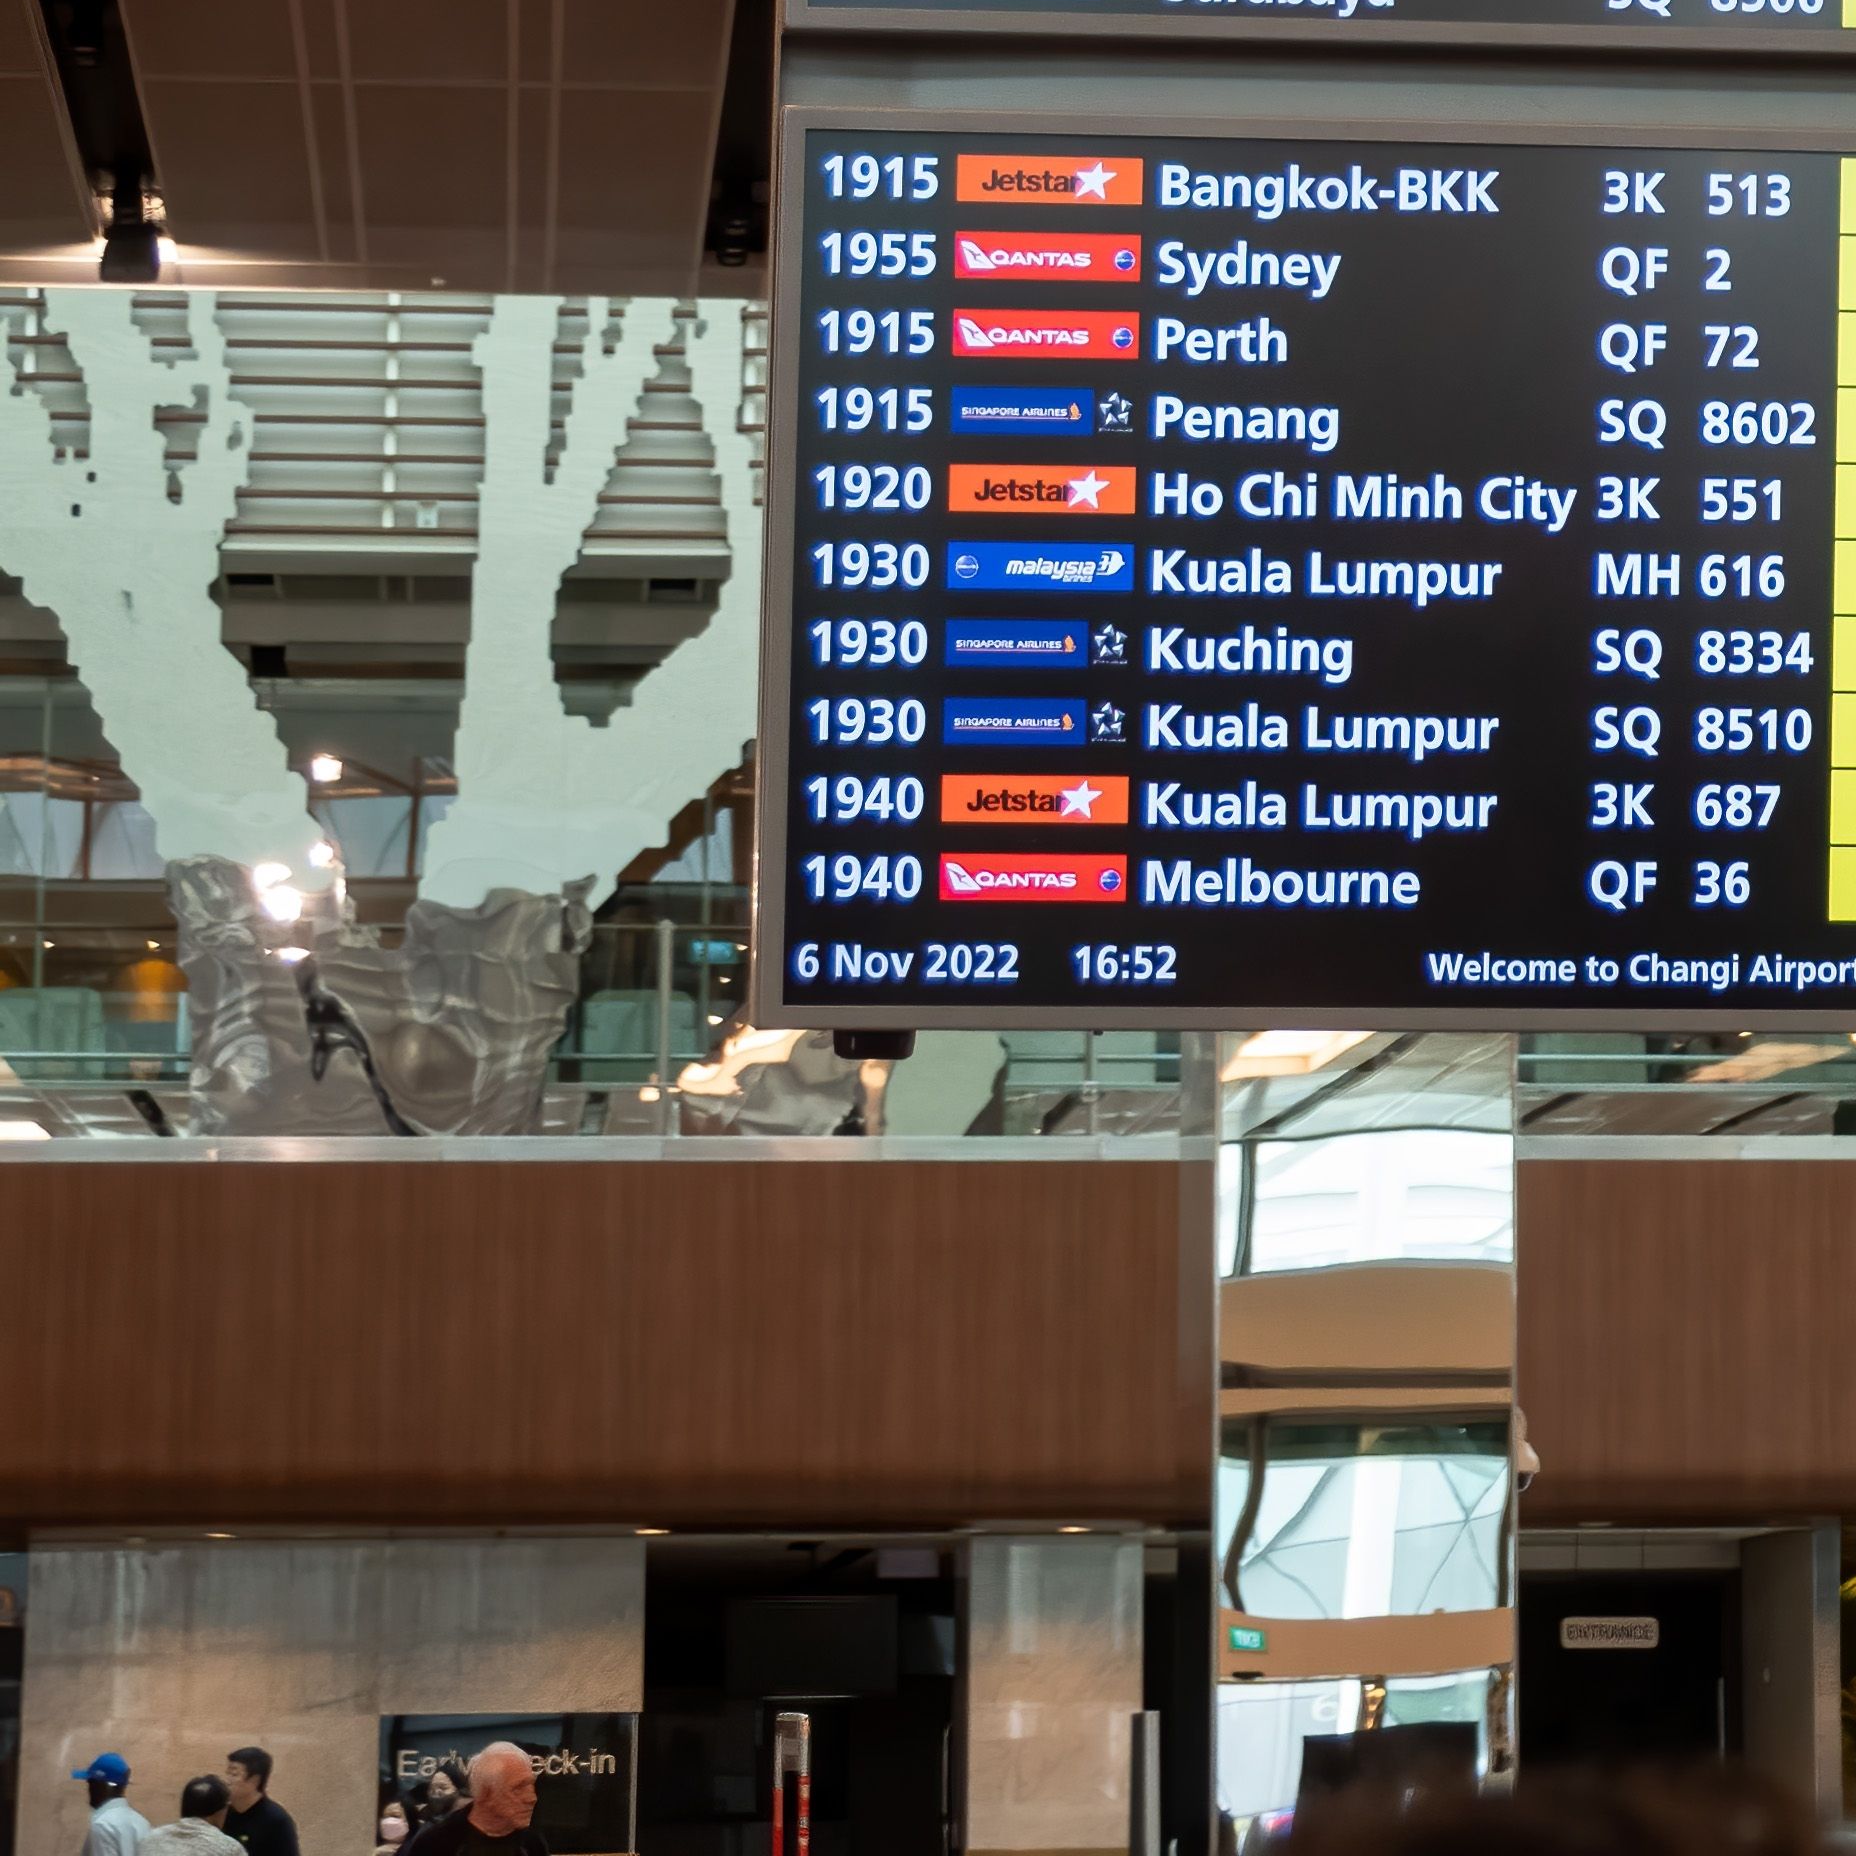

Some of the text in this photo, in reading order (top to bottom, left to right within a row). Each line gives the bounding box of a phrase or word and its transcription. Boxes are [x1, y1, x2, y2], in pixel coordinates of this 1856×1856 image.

[823, 233, 936, 275] 1955
[990, 249, 1092, 267] QANTAS
[1159, 241, 1341, 297] Sydney
[1603, 247, 1668, 295] QF
[1706, 249, 1731, 290] 2
[817, 466, 931, 508] 1920
[974, 479, 1068, 503] Jetstar
[1155, 473, 1223, 515] Ho
[1240, 472, 1317, 516] Chi
[1337, 474, 1462, 518] Minh
[1481, 476, 1577, 531] City
[1598, 477, 1660, 518] 3K
[1704, 479, 1781, 520] 551
[800, 944, 1176, 979] 6 Nov 2022 16:52
[1429, 953, 1576, 981] Welcome
[1586, 957, 1619, 981] to
[1630, 953, 1739, 989] Changi
